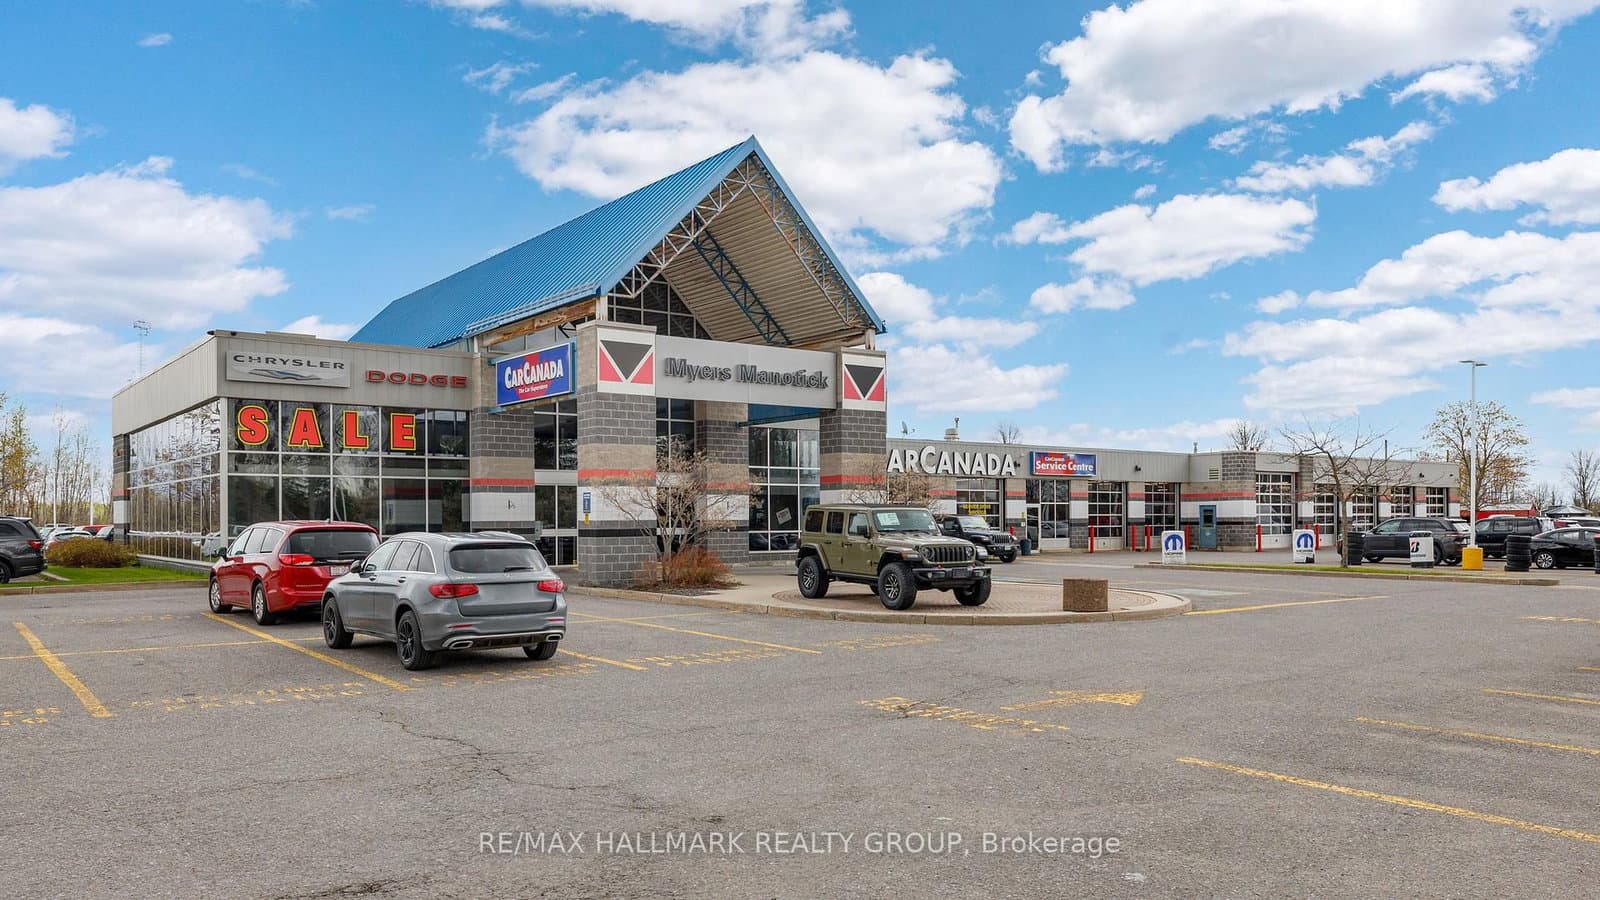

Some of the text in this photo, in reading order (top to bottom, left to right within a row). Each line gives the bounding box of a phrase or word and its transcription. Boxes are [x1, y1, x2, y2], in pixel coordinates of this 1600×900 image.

[232, 354, 345, 370] CHRYSLER
[504, 359, 564, 389] CARCANADA
[665, 357, 828, 389] Myers Manotick
[366, 370, 468, 388] DODGE
[886, 445, 1016, 476] ARCANADA
[1036, 460, 1094, 472] Service Centre
